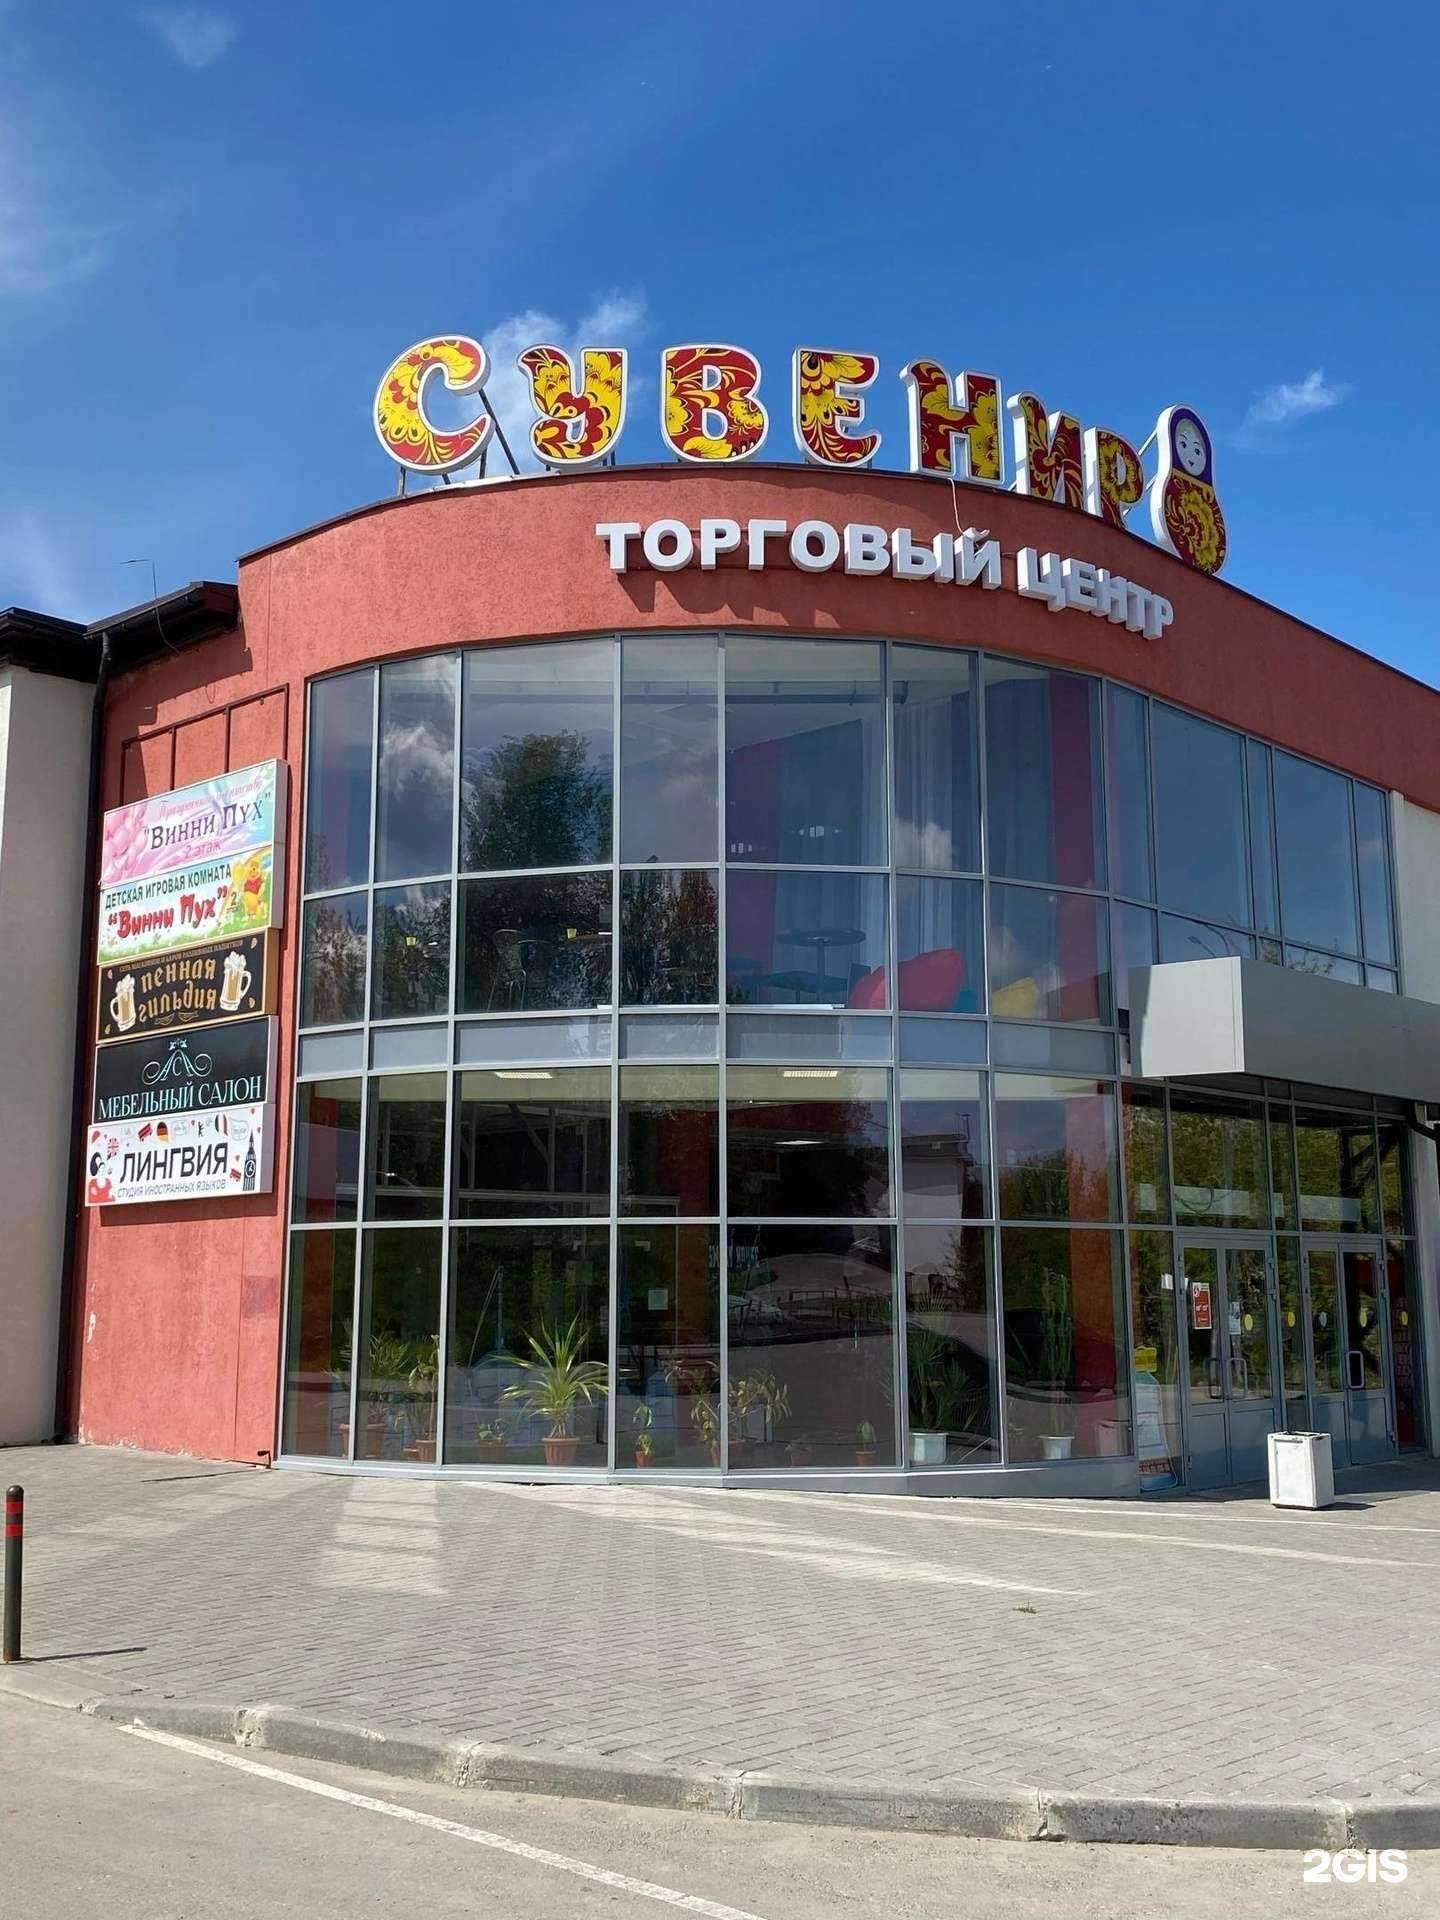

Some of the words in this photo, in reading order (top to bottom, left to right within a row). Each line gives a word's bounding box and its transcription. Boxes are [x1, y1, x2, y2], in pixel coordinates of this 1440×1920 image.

[373, 334, 1146, 528] СУВЕНИР
[596, 519, 1001, 591] ТОРГОВЫЙ
[1016, 547, 1174, 641] ЦЕНТР
[105, 886, 143, 910] ДЕТСКАЯ
[145, 875, 185, 899] ИГРОВАЯ
[188, 863, 232, 889] КОМНАТА
[98, 1081, 194, 1120] МЕБЕЛЬНЫЙ
[198, 1075, 262, 1106] САЛОН
[119, 1142, 229, 1183] ЛИНГВИЯ
[117, 1184, 143, 1199] СТУДИЯ
[145, 1181, 196, 1198] ИНОСТРАННЫХ
[197, 1178, 227, 1192] ЯЗЫКОВ
